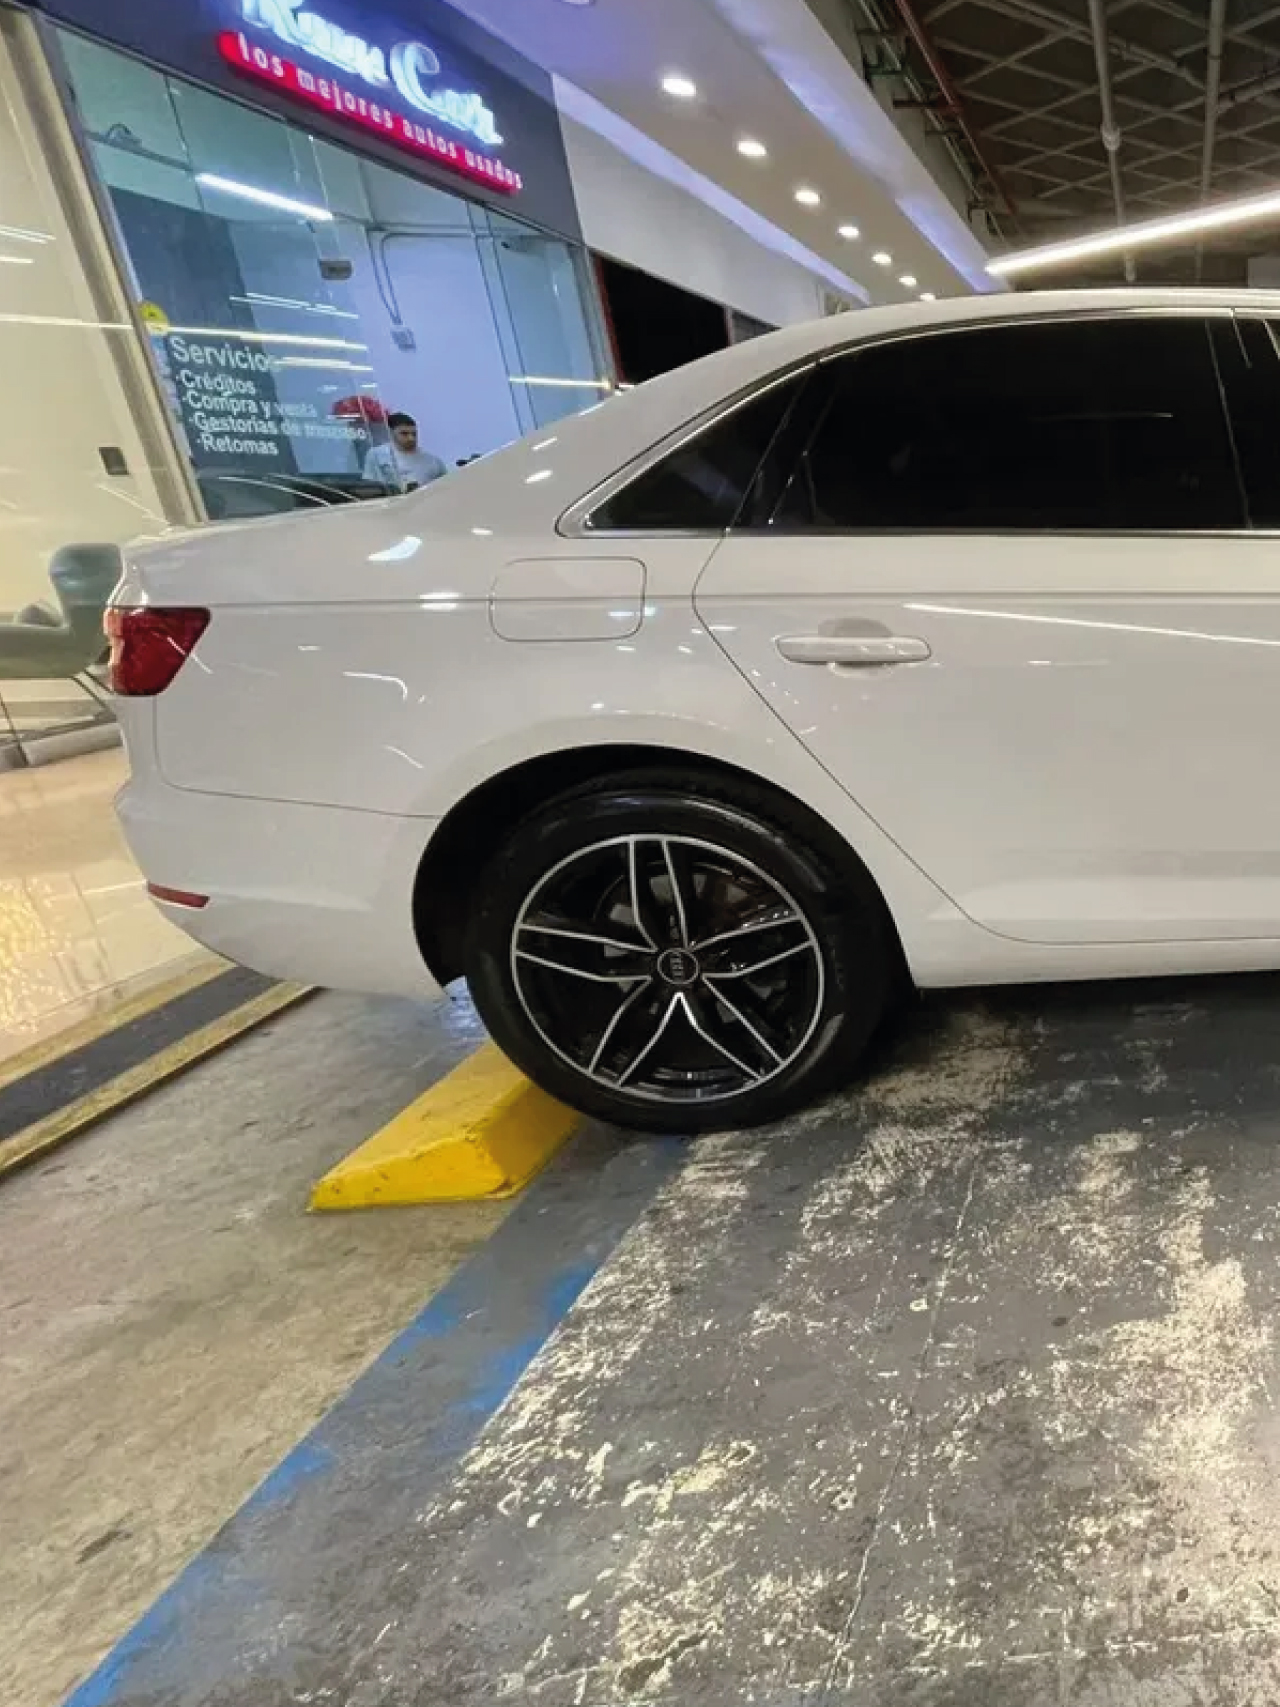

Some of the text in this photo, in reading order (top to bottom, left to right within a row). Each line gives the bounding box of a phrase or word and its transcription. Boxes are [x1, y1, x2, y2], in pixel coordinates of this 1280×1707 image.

[237, 32, 523, 189] los mejores autos usados
[179, 369, 256, 396] Créditos
[186, 388, 258, 416] Compra
[258, 400, 271, 419] y
[201, 433, 279, 456] Retomas
